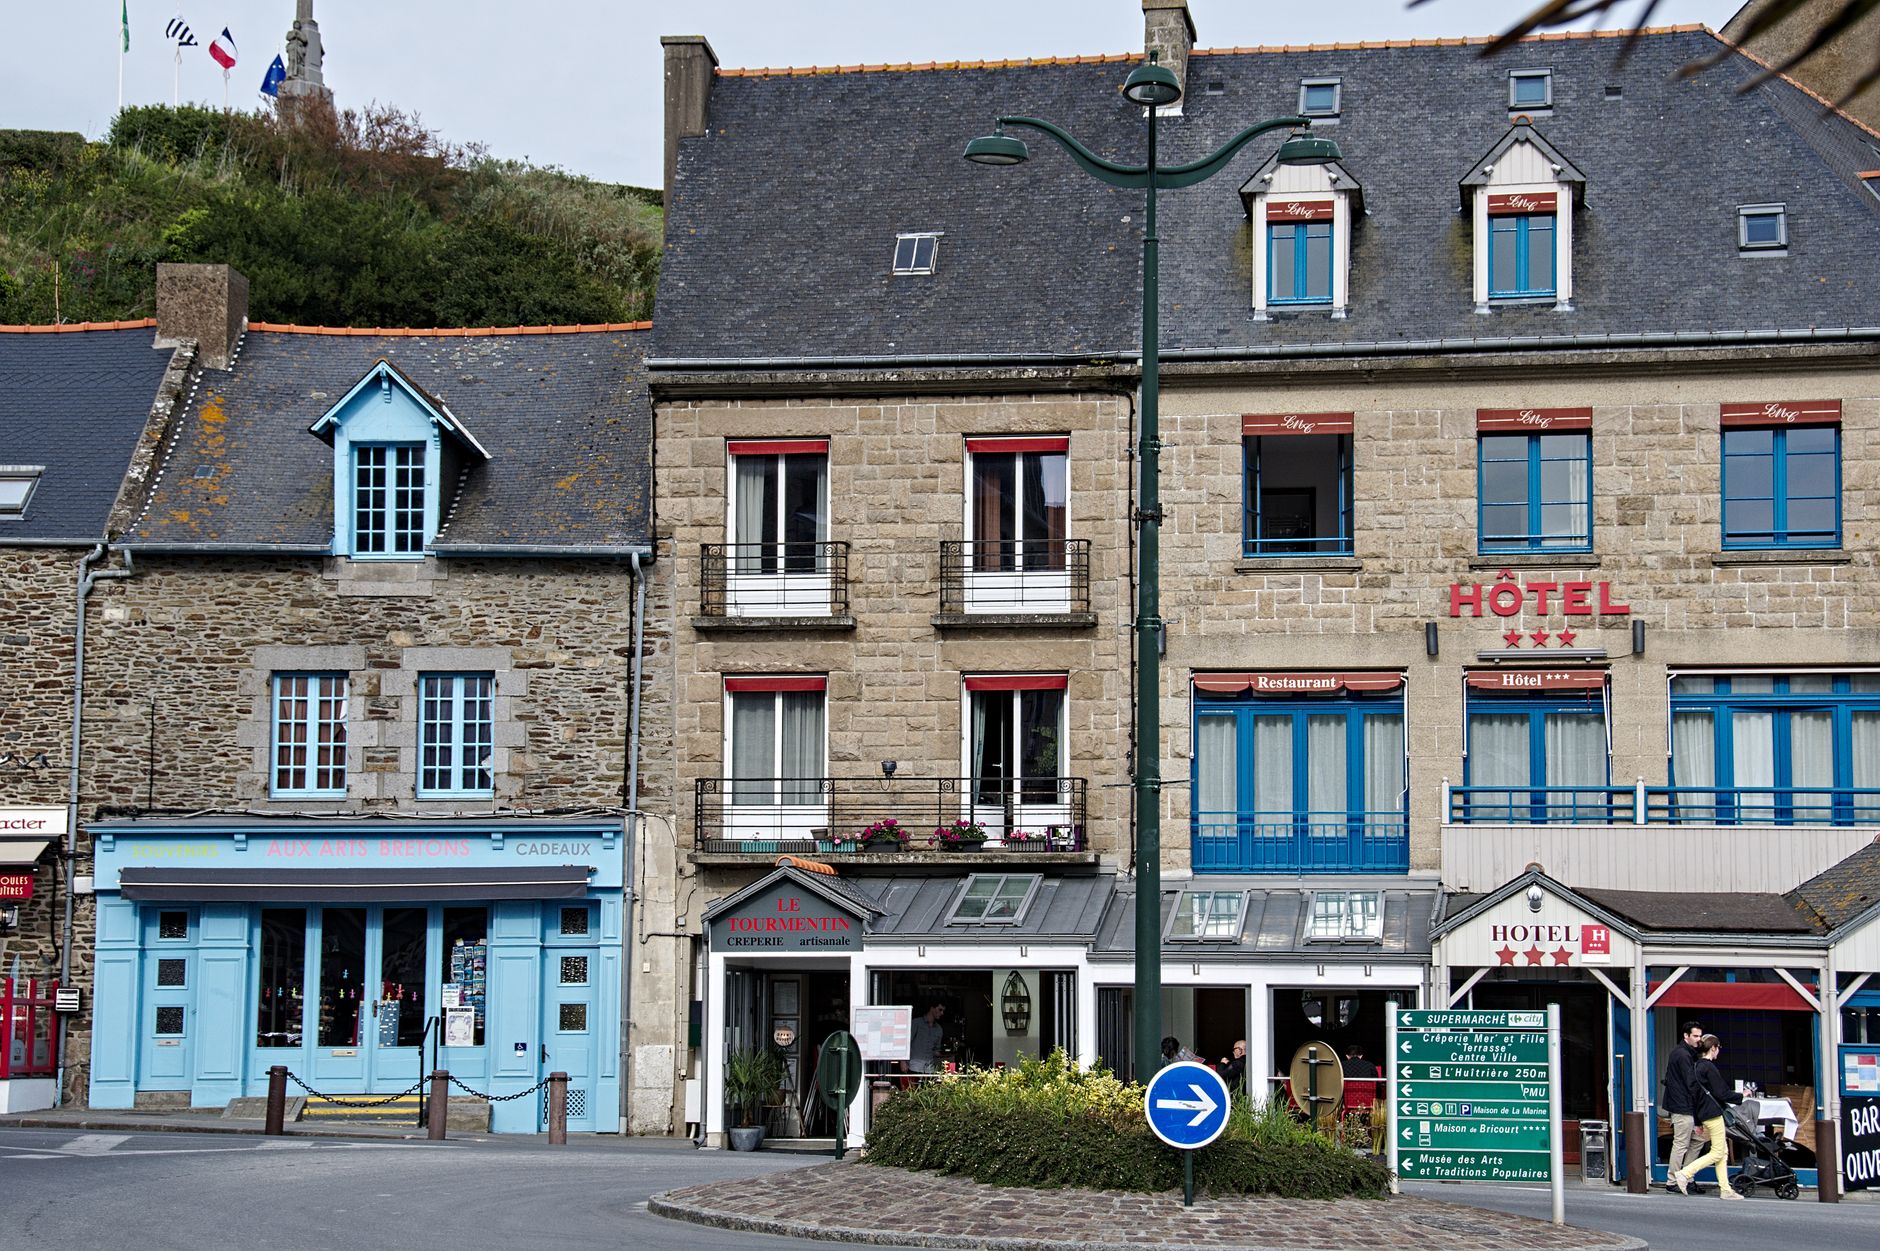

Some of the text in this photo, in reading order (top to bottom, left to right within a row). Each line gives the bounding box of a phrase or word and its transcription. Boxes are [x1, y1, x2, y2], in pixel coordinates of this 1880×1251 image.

[1449, 568, 1630, 617] HÔTEL
[1257, 676, 1336, 689] Restaurant
[1502, 674, 1542, 686] Hôtel
[267, 838, 471, 857] AUX ARTS BRETONS
[516, 842, 591, 856] CADEAUX
[777, 897, 801, 912] LE
[727, 917, 850, 932] TOURMENTIN
[1491, 924, 1579, 942] HOTEL
[1592, 929, 1606, 941] H
[727, 936, 850, 946] CREPERIE artisanale
[1427, 1012, 1543, 1025] SUPERMARCHÉ city
[1422, 1033, 1469, 1044] Crêperie
[1503, 1035, 1514, 1043] et
[1520, 1034, 1545, 1043] Fille
[1450, 1052, 1518, 1062] Centre Ville
[1522, 1087, 1546, 1097] PMU
[1473, 1106, 1498, 1114] Maison
[1523, 1107, 1547, 1115] Marine
[1434, 1123, 1467, 1133] Maison
[1479, 1124, 1519, 1133] Bricourt
[1419, 1154, 1504, 1165] Musée des Arts
[1420, 1167, 1548, 1179] et Traditions Populaires
